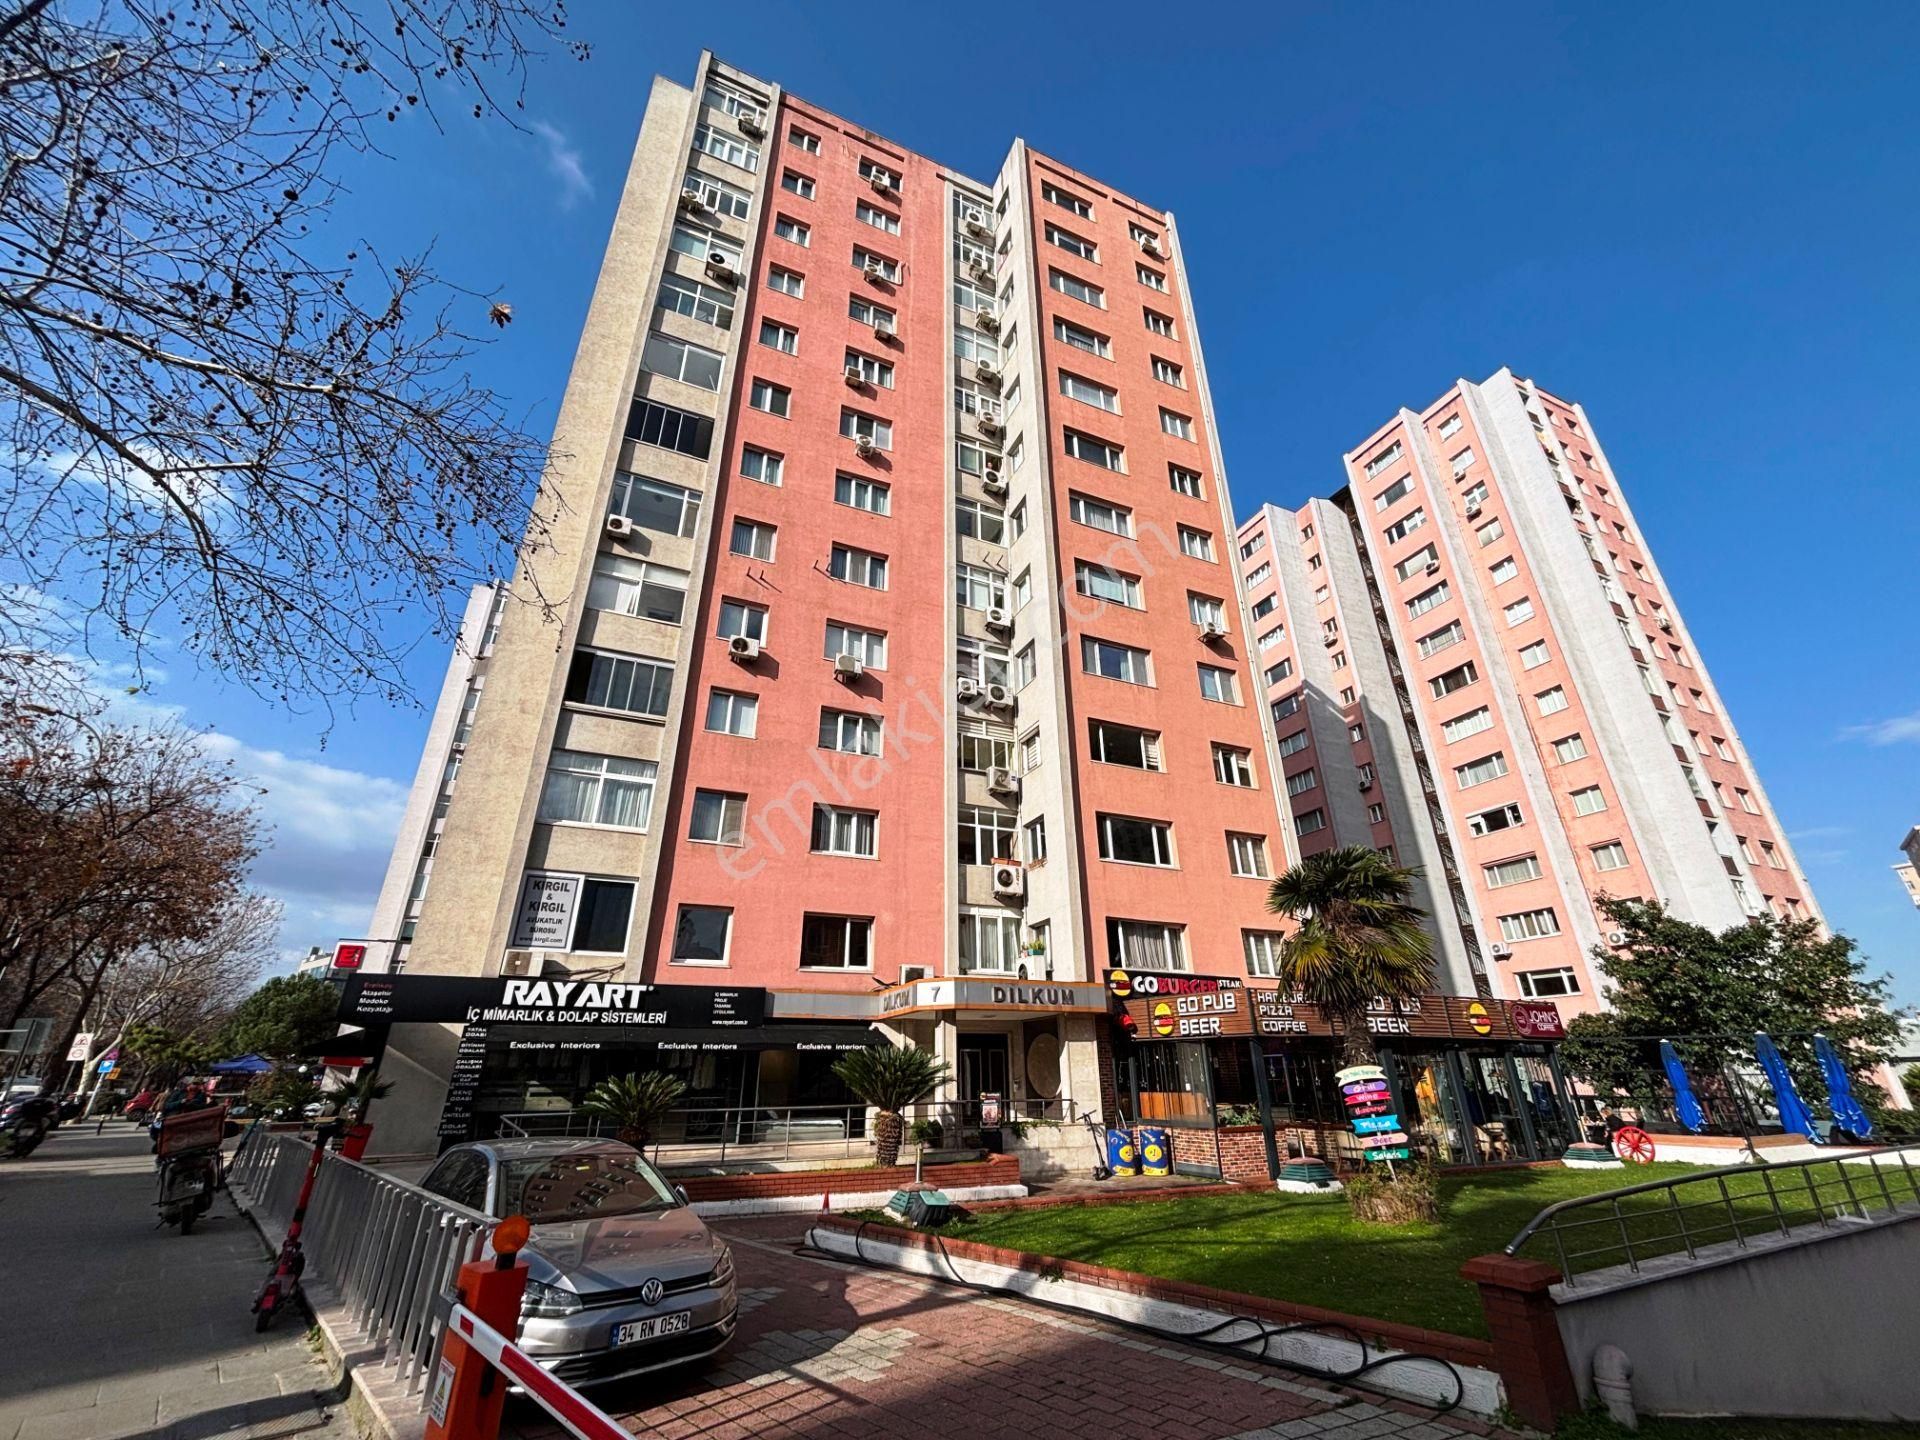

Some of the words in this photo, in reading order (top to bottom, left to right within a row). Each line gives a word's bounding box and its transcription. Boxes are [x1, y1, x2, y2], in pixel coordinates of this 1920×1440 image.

[532, 881, 570, 892] KIRGIL
[528, 901, 566, 913] KIRGIL
[1219, 980, 1240, 988] STEAK
[502, 980, 647, 1008] RAYART
[930, 986, 941, 1002] 7
[991, 986, 1075, 1005] DILKUM
[1177, 995, 1199, 1013] GO
[1203, 992, 1236, 1011] PUB
[466, 1006, 481, 1023] İÇ
[483, 1007, 544, 1022] MİMARLIK
[546, 1012, 555, 1022] &
[558, 1011, 599, 1023] DOLAP
[600, 1010, 667, 1024] SİSTEMLERİ
[1259, 1005, 1293, 1016] PIZZA
[1529, 1010, 1559, 1024] JOHN'S
[1179, 1017, 1221, 1035] BEER
[1262, 1021, 1307, 1032] COFFEE
[1366, 1017, 1410, 1033] BEER
[509, 1041, 555, 1049] Exclusive
[657, 1042, 698, 1050] Exclusive
[619, 1325, 634, 1343] 34
[640, 1320, 656, 1338] RN
[660, 1313, 688, 1333] 0528
